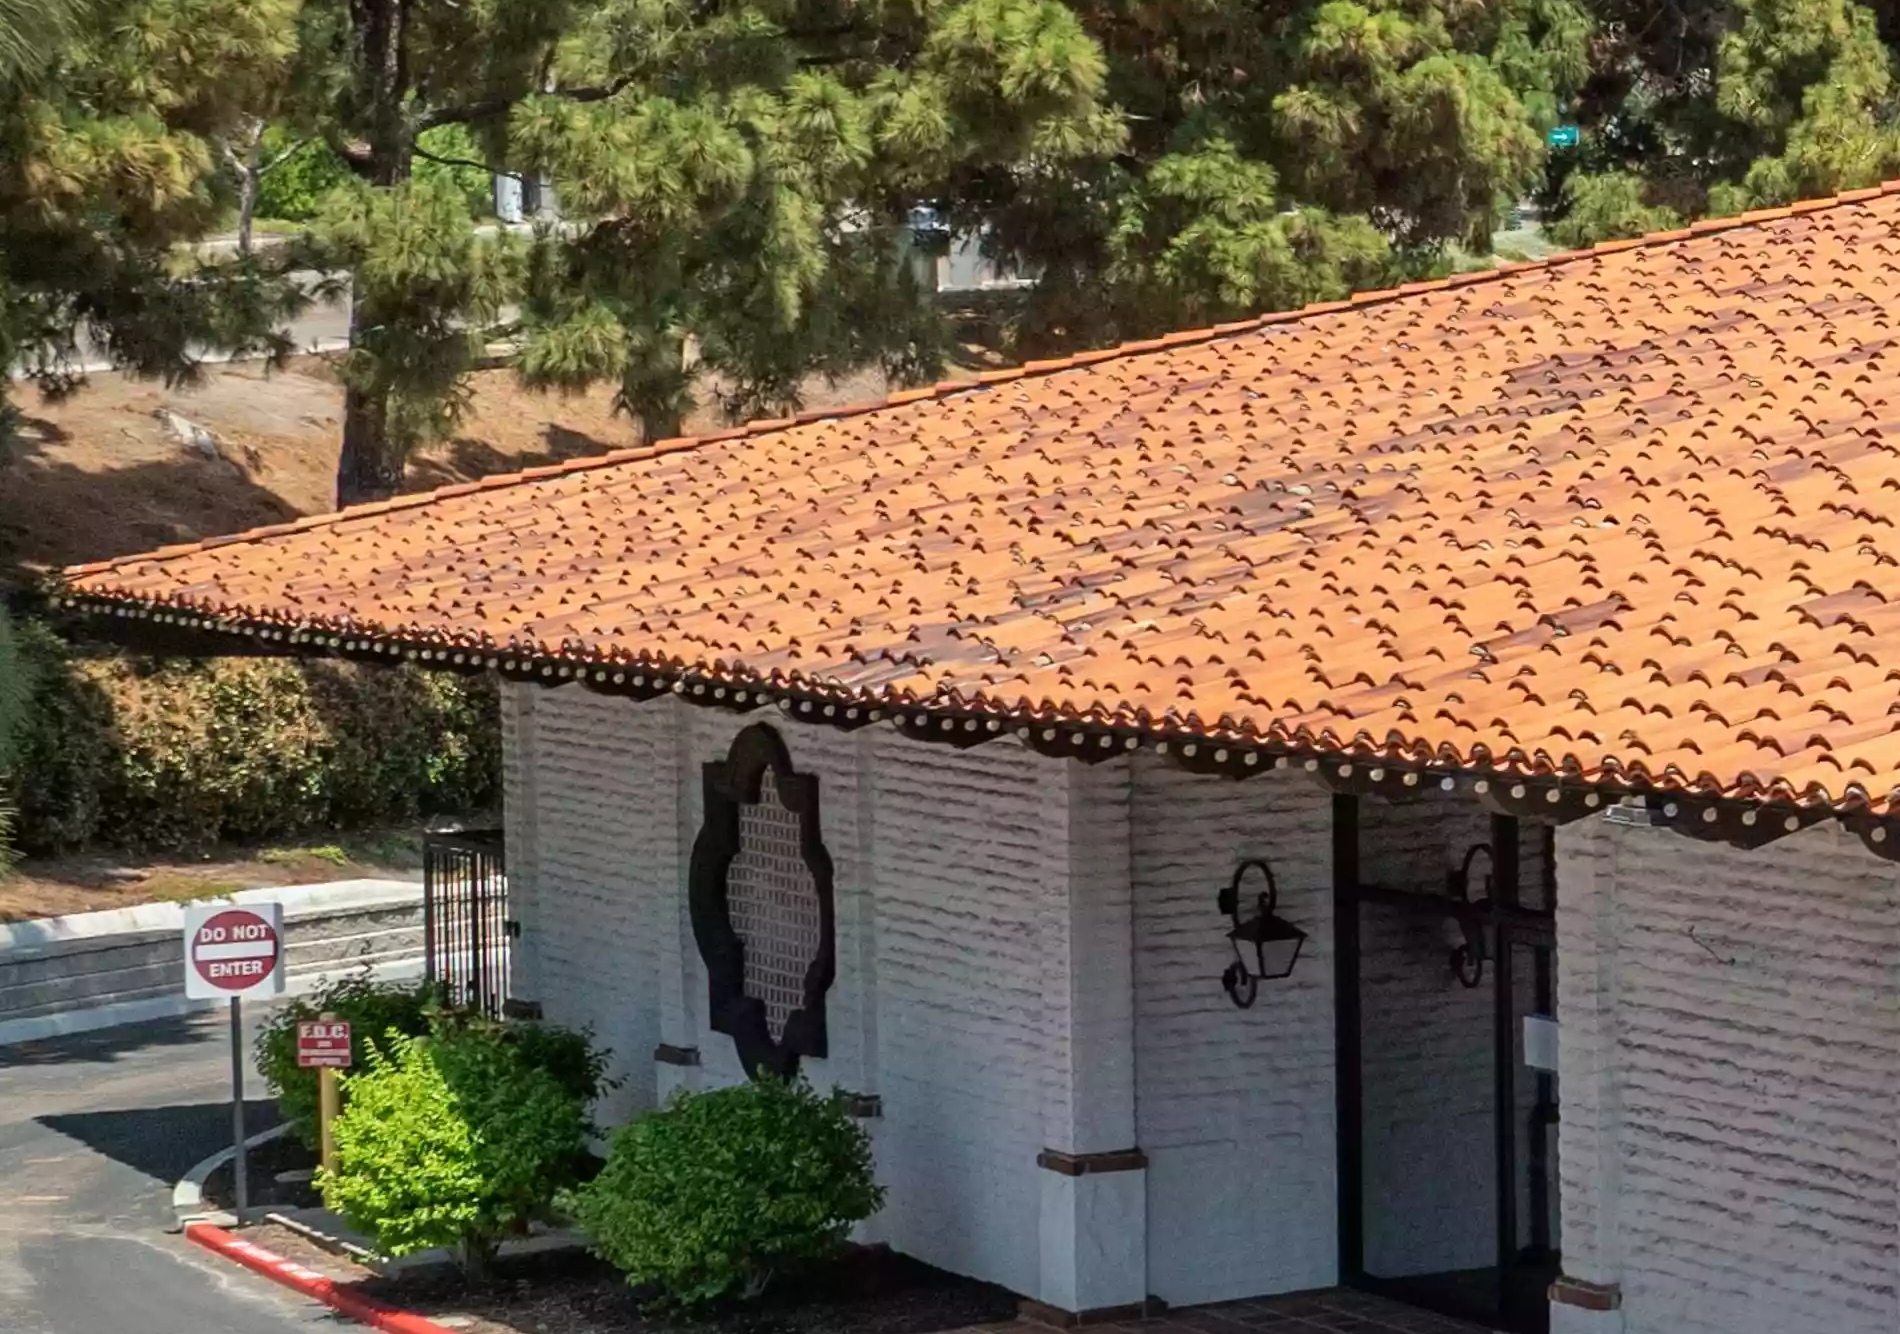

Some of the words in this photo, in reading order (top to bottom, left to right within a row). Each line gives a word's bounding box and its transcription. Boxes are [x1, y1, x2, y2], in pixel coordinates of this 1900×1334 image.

[201, 927, 226, 942] DO
[233, 924, 267, 940] NOT
[209, 961, 263, 977] ENTER
